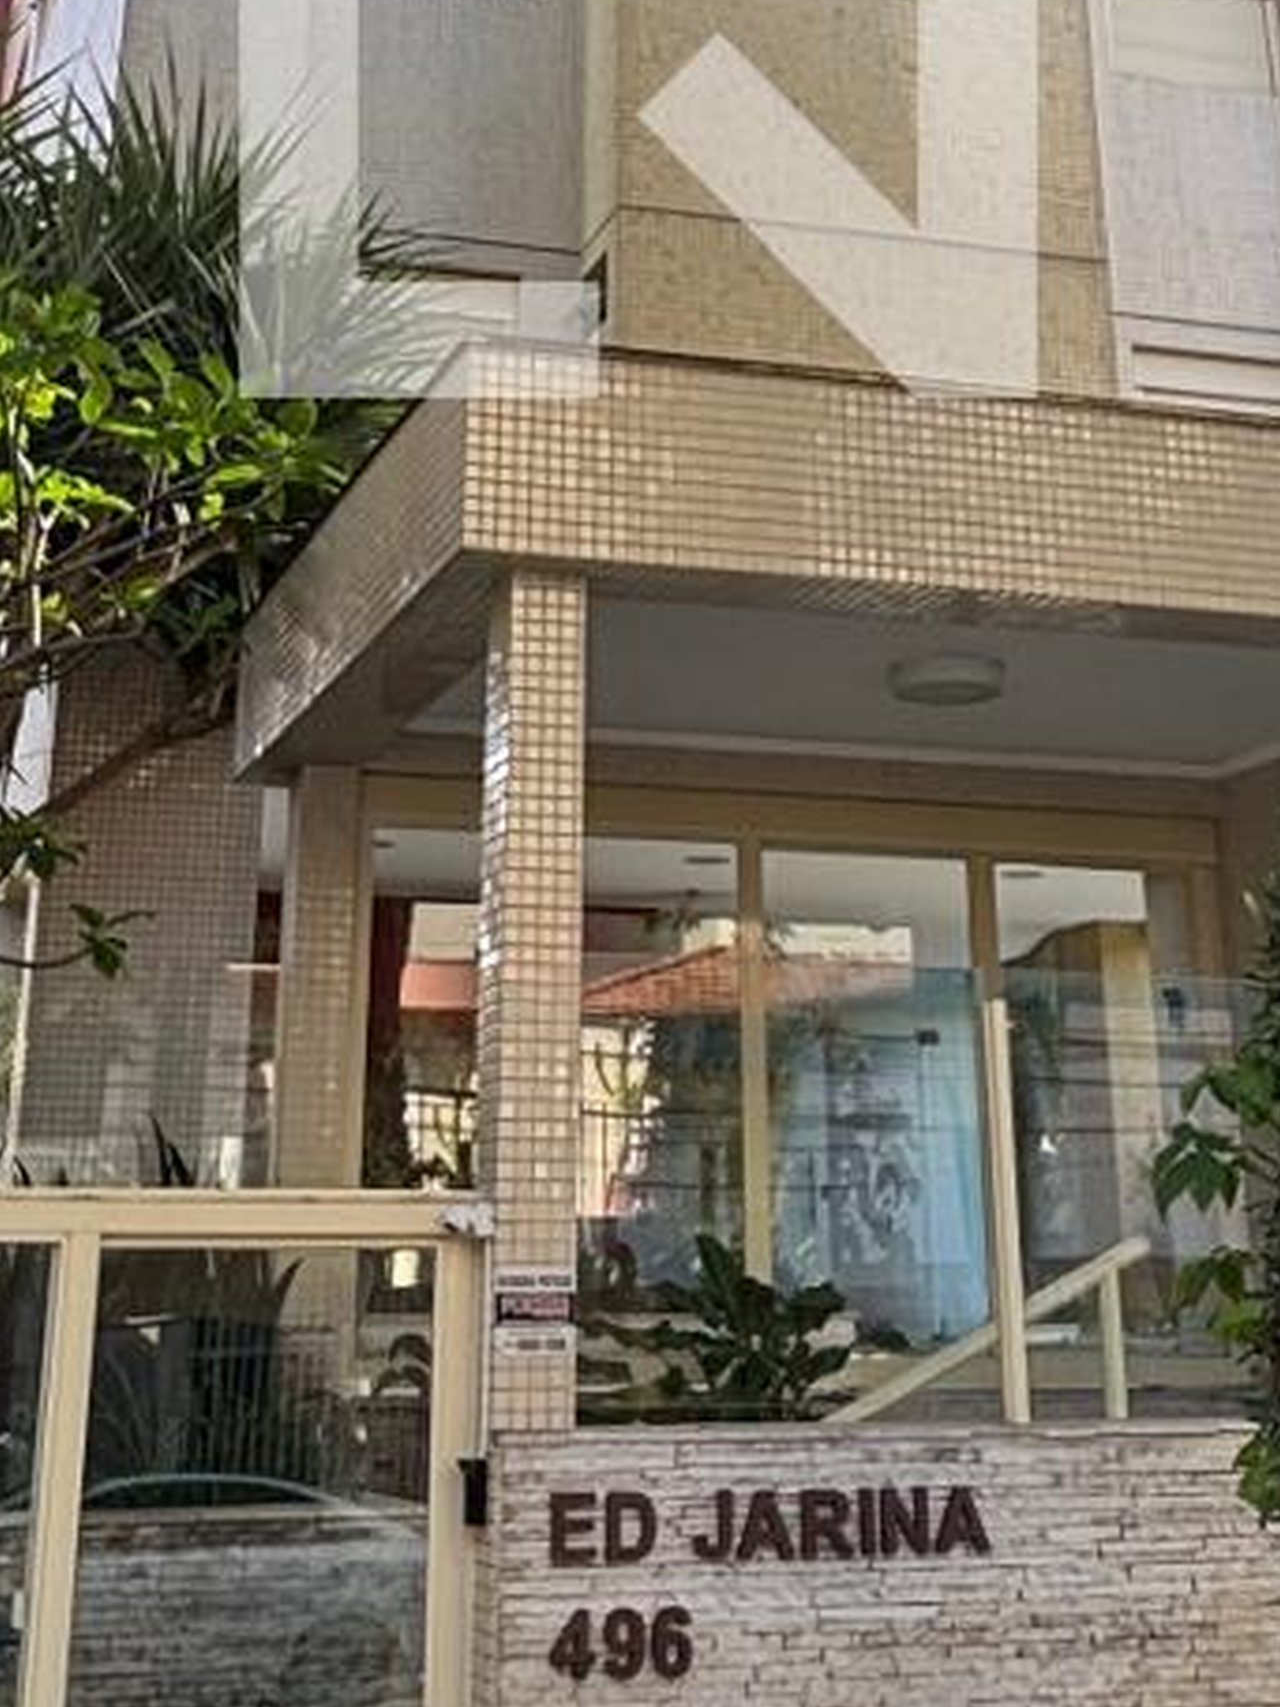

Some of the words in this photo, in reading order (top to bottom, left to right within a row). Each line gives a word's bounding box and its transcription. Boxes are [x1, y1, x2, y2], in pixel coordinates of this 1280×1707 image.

[549, 1490, 658, 1566] ED
[692, 1485, 992, 1561] JARINA
[549, 1605, 694, 1680] 496
